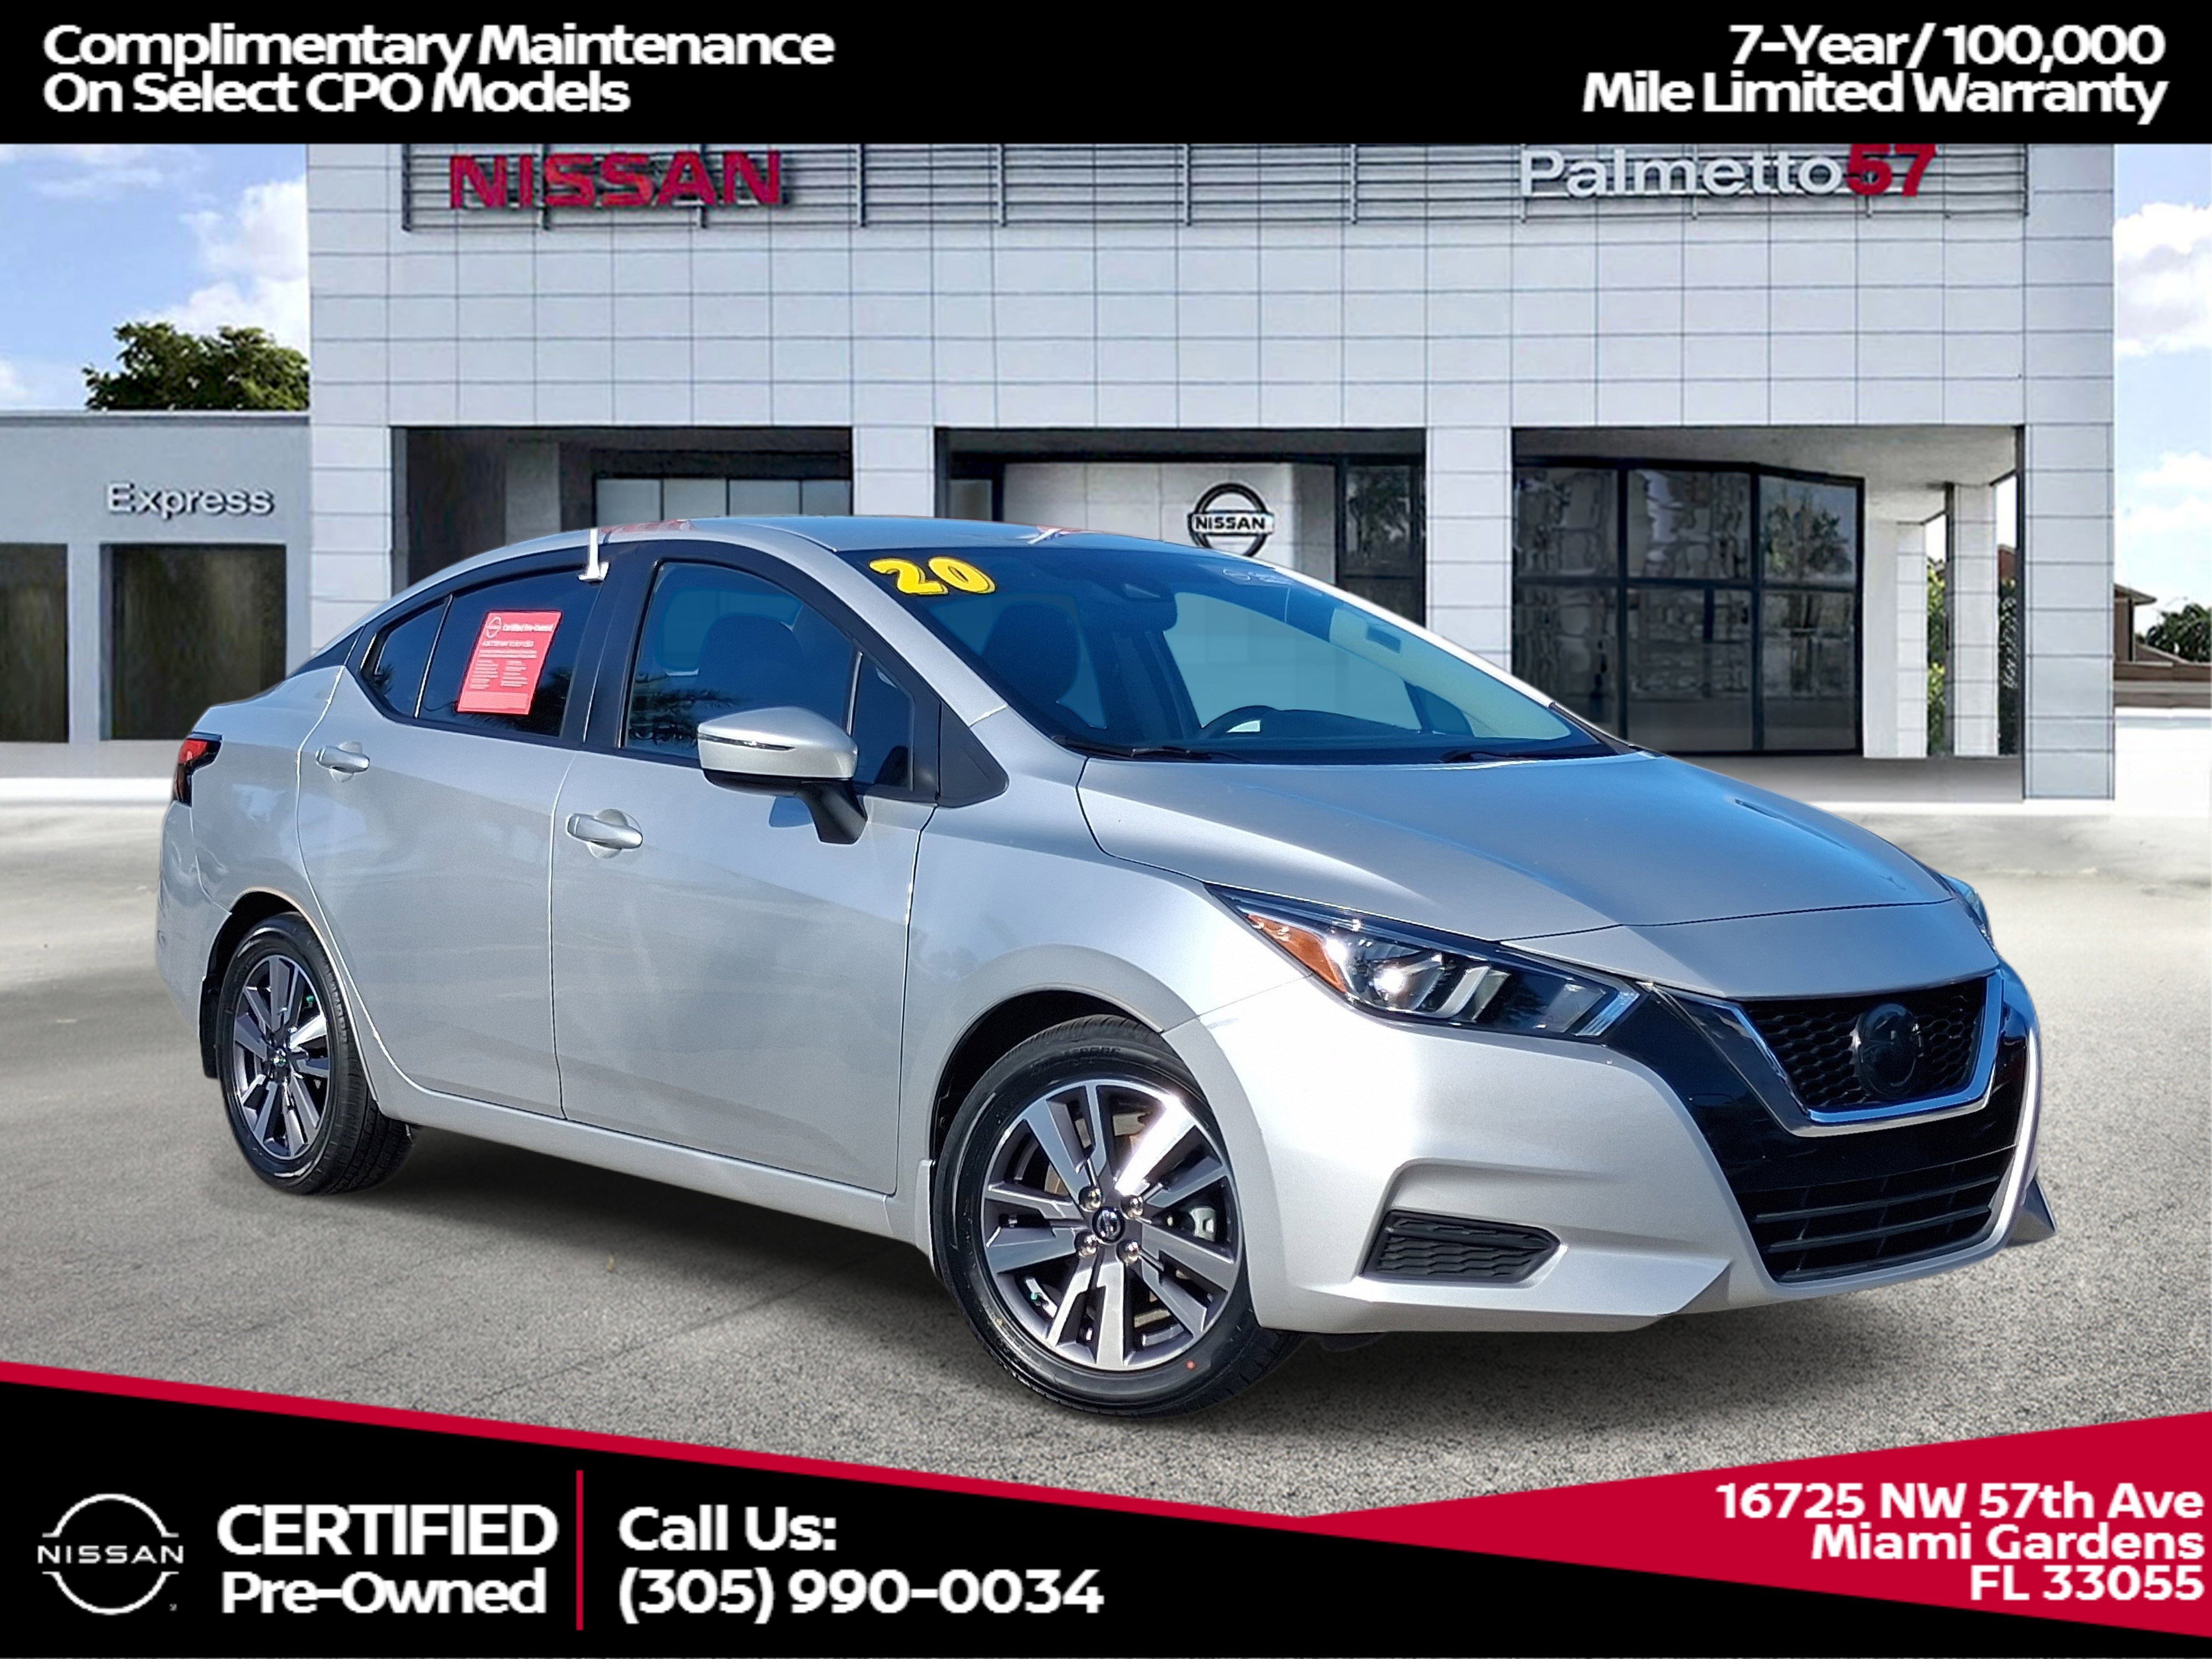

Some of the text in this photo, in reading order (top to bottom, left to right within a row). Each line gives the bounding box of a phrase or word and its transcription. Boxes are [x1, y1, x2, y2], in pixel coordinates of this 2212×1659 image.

[449, 151, 782, 209] NISSAN
[107, 482, 275, 520] Express
[1194, 516, 1266, 530] NISSAN
[869, 556, 997, 596] 20
